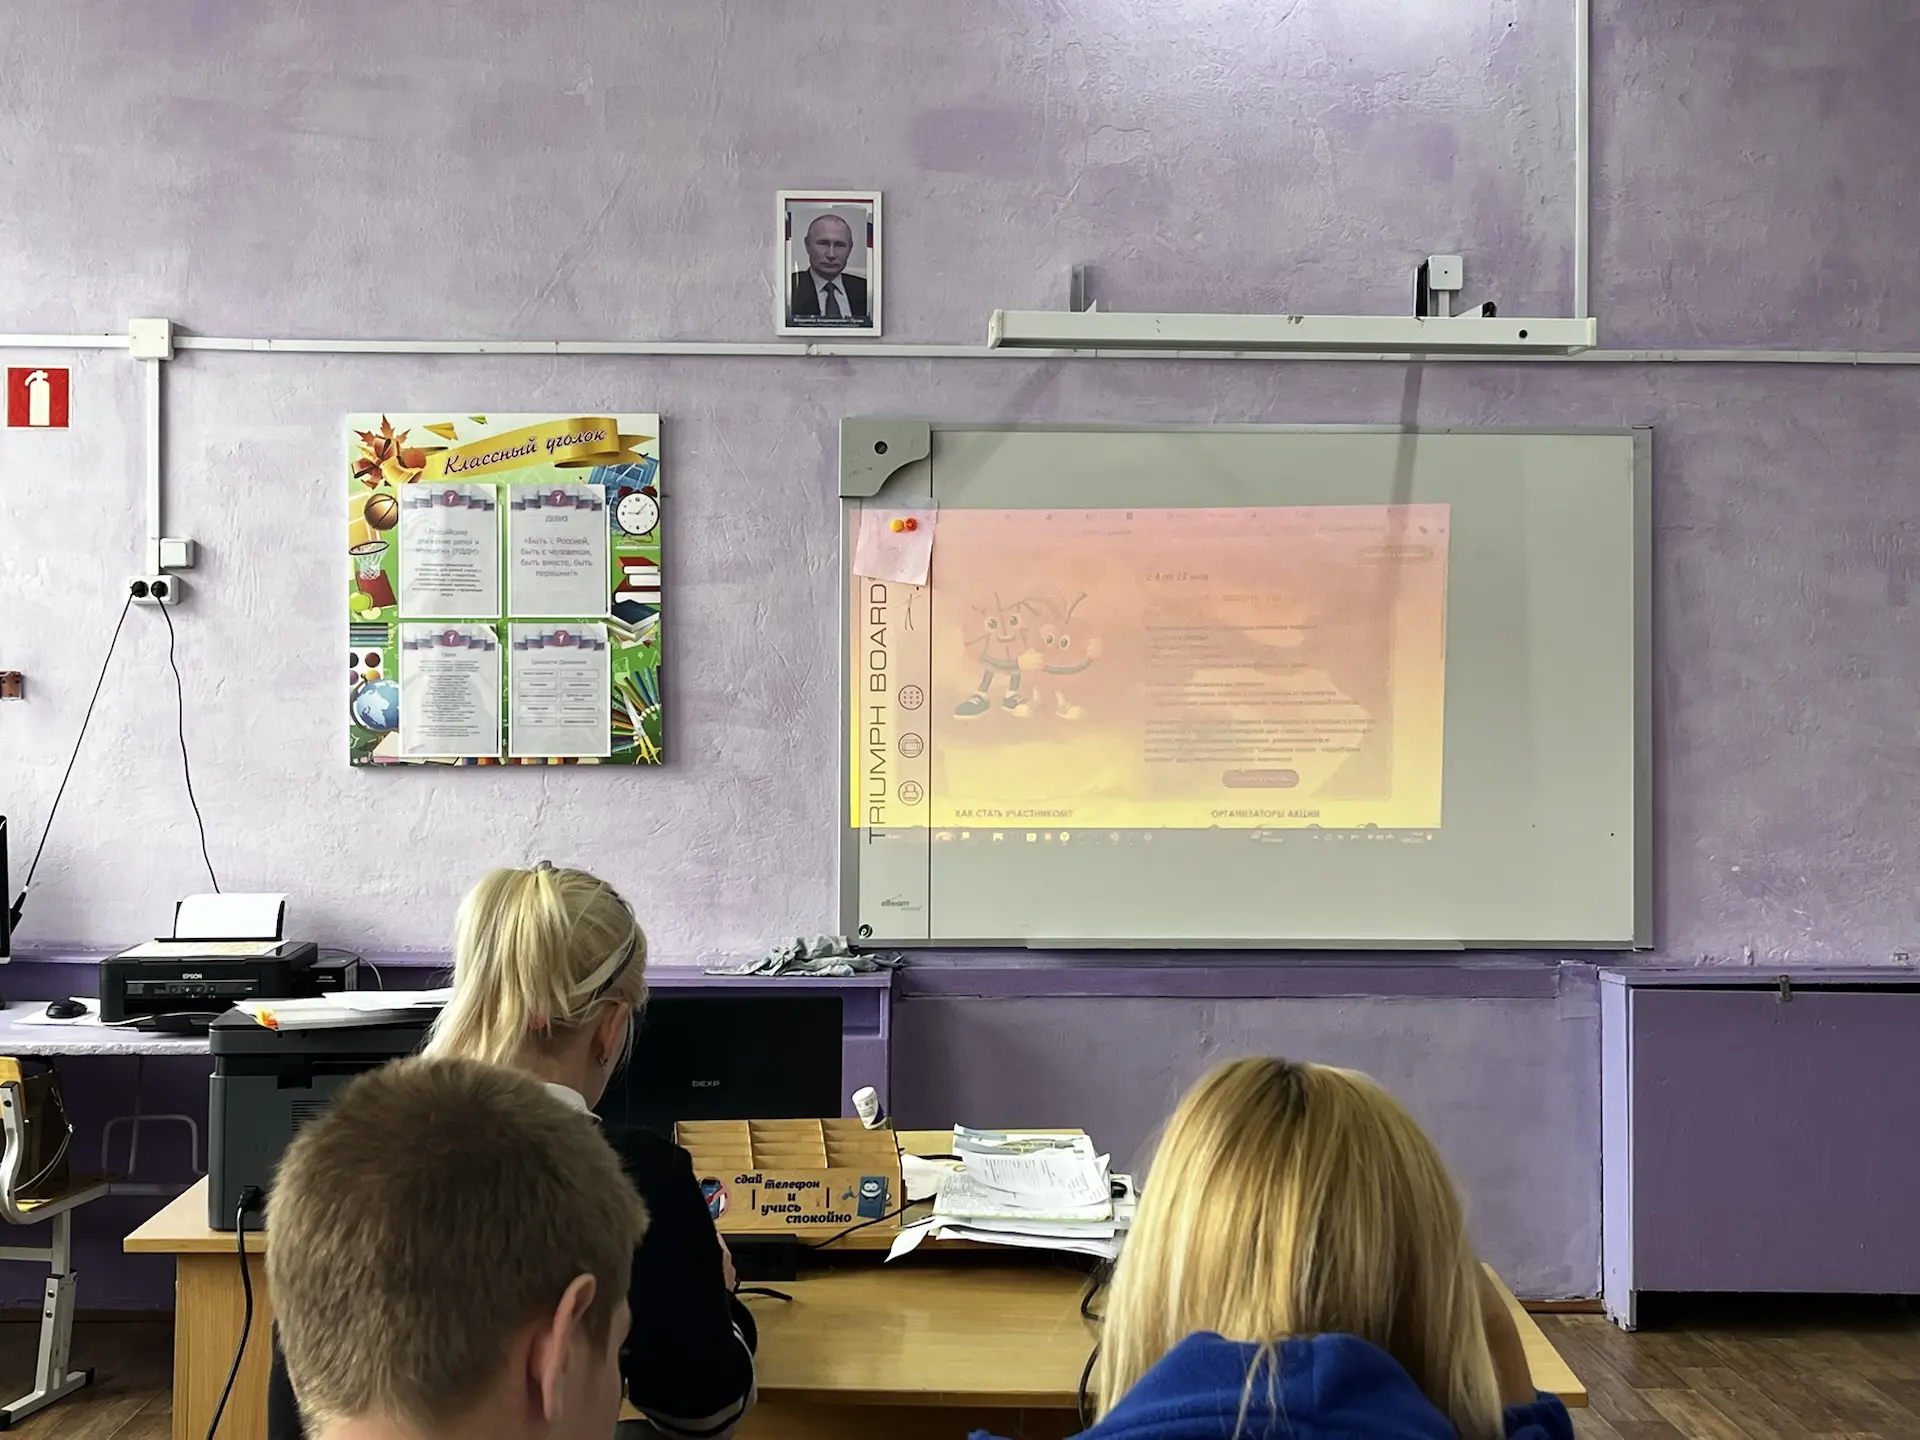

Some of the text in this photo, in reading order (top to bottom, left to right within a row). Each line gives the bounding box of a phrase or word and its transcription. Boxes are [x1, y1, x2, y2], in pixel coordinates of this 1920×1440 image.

[444, 428, 607, 475] Классный уголок
[869, 584, 887, 845] TRIUMPH BOARD
[955, 809, 1073, 818] КАК СТАТЬ УЧАСТНИКОМ?
[1211, 809, 1321, 819] ОРГАНИЗАТОРЫ АКЦИИ
[734, 1173, 762, 1185] сдай
[764, 1179, 820, 1189] телефон
[787, 1193, 796, 1202] и
[761, 1203, 802, 1216] учись
[785, 1211, 852, 1224] спокойно
